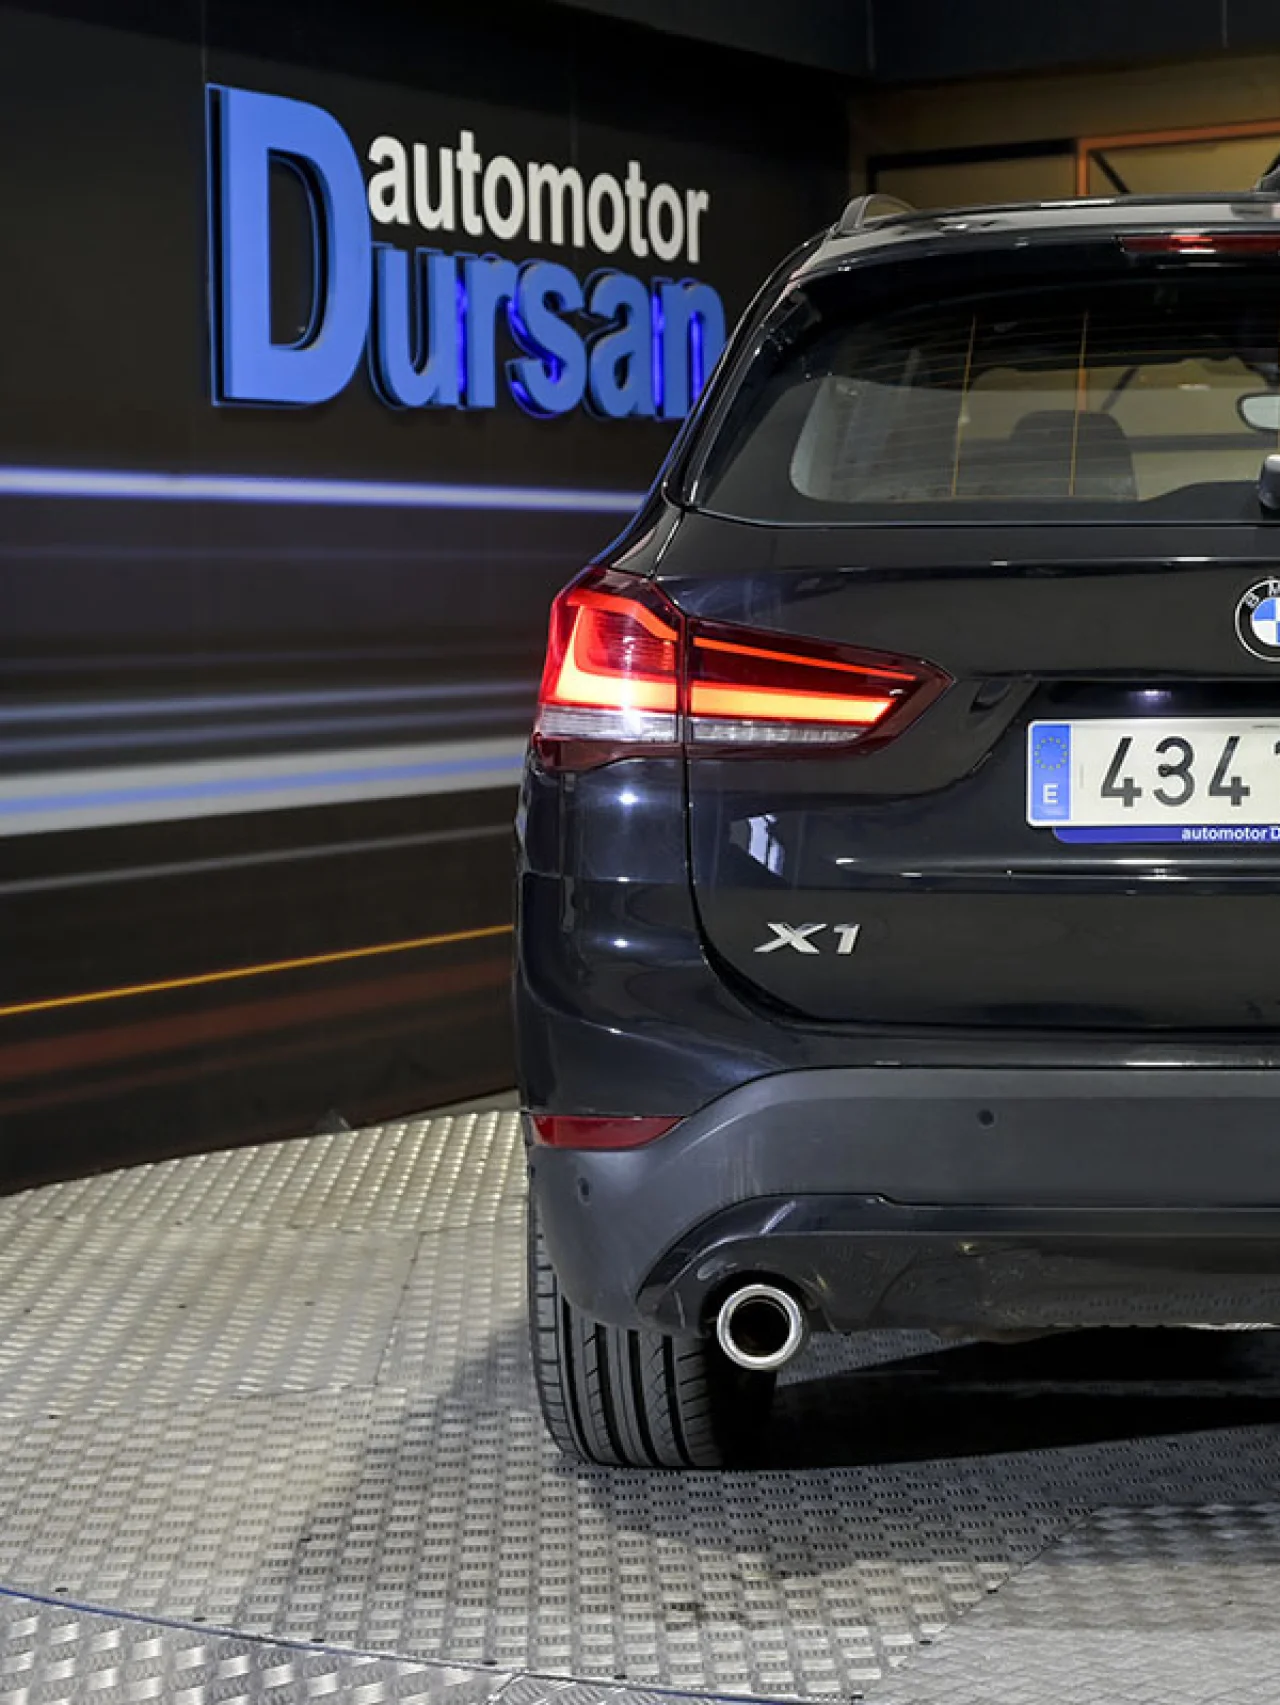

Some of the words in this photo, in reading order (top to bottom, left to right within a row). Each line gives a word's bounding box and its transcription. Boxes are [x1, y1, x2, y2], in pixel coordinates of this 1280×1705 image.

[367, 130, 709, 262] automotor
[204, 82, 726, 423] Dursan
[1042, 783, 1058, 804] E
[754, 923, 860, 954] X1
